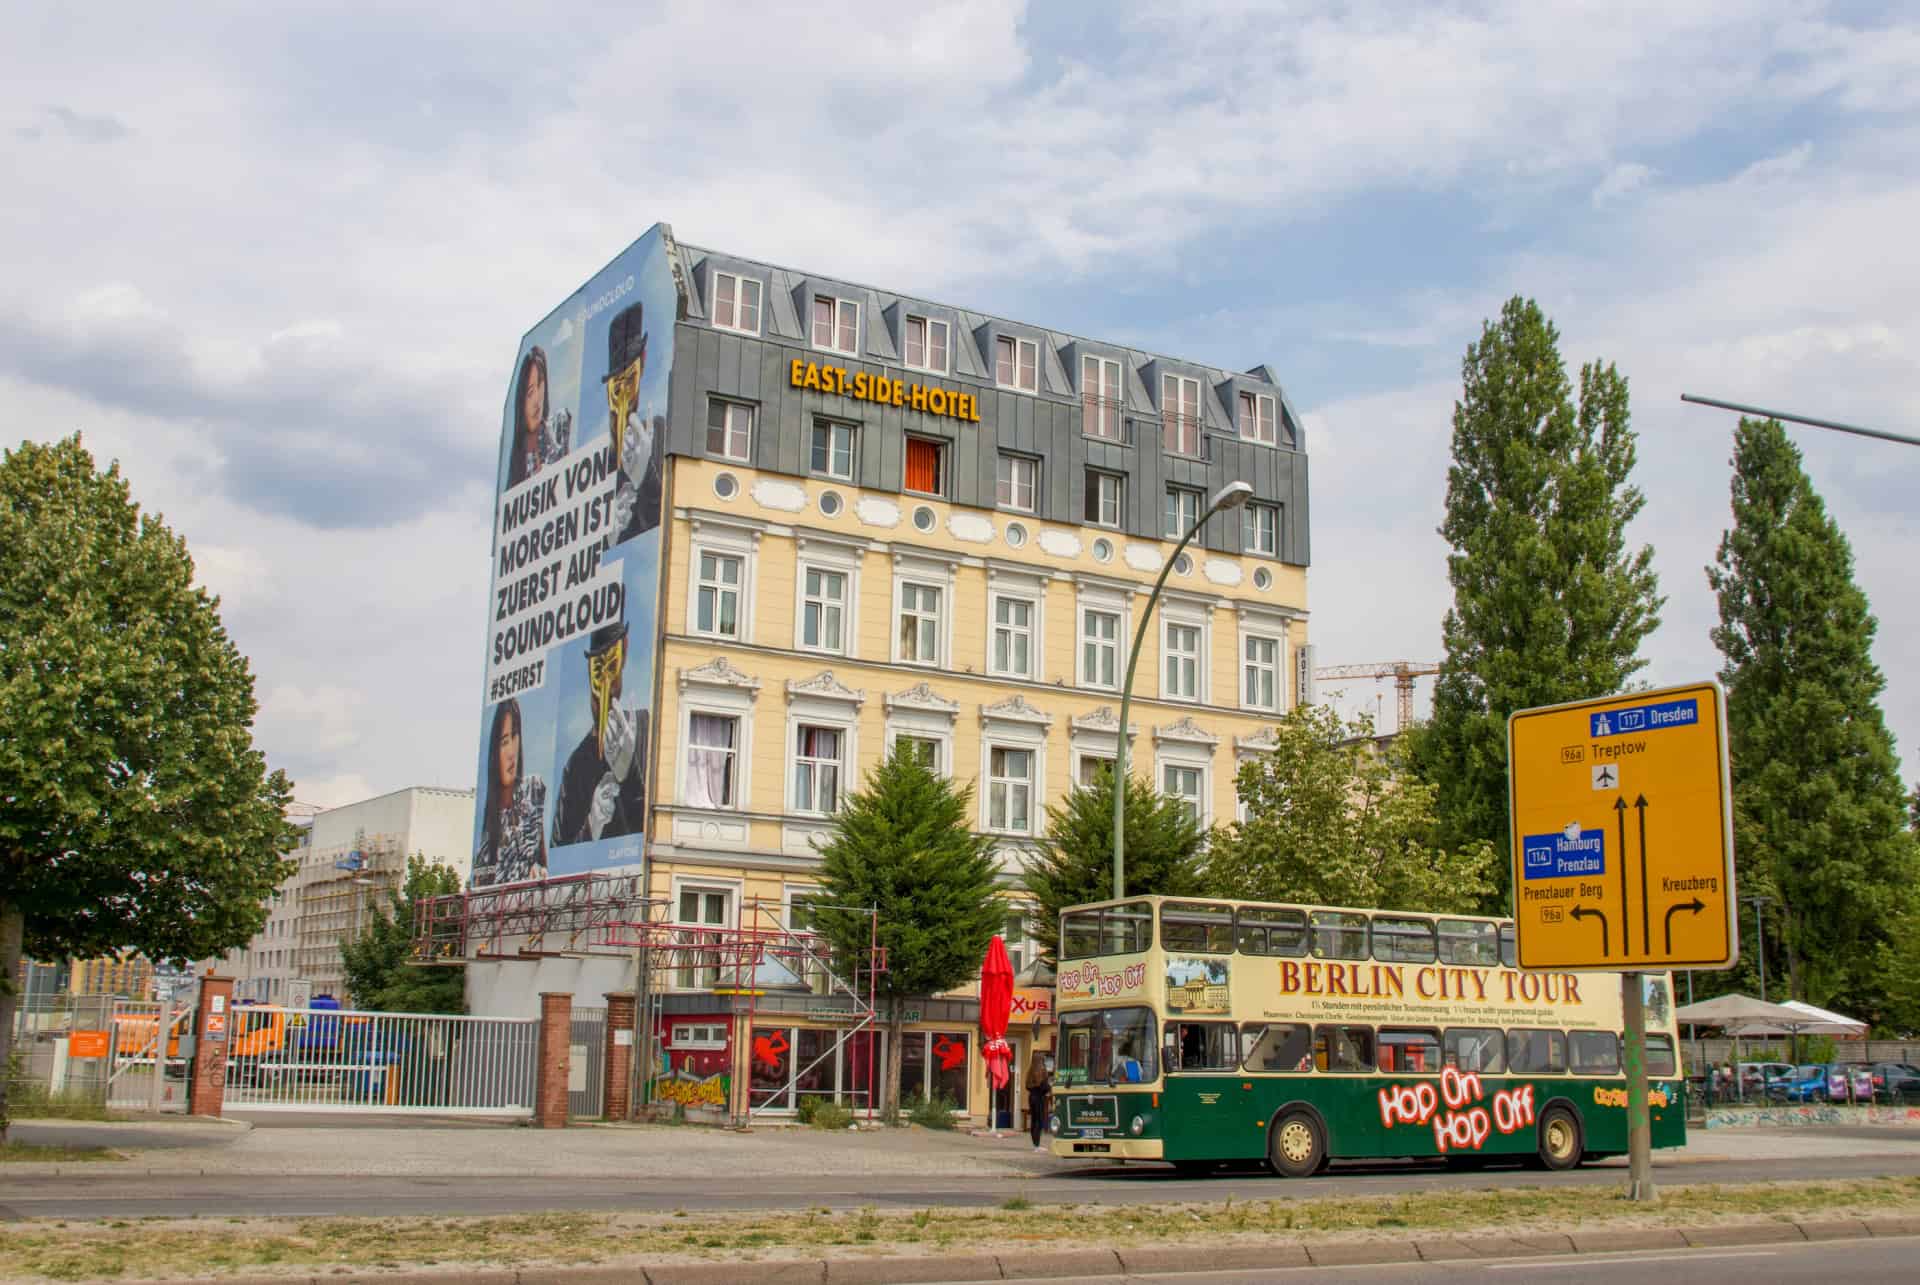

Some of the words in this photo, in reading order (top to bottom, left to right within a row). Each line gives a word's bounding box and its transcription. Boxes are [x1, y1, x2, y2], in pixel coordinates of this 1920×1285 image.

[502, 474, 560, 535] MUSIK
[565, 446, 610, 499] VON
[500, 507, 580, 578] MORGEN
[583, 488, 615, 537] IST
[496, 560, 562, 622] ZUERST
[565, 548, 604, 591] AUF
[493, 581, 621, 666] SOUNDCLOUD
[491, 660, 544, 702] #SCFIRST
[1622, 712, 1640, 728] 117
[1651, 706, 1694, 725] Dresden
[1563, 748, 1582, 761] 96a
[1592, 740, 1646, 760] Treptow
[1531, 850, 1547, 864] 114
[1557, 836, 1600, 853] Hamburg
[1557, 856, 1600, 873] Prenzlau
[1524, 884, 1575, 900] Prenzlauer
[1580, 882, 1603, 900] Berg
[1662, 875, 1718, 892] Kreuzberg
[1543, 908, 1562, 921] 96a
[1279, 960, 1405, 1000] BERLIN
[1416, 966, 1490, 1001] CITY
[1500, 971, 1583, 1005] TOUR
[1440, 1064, 1483, 1112] On
[1493, 1083, 1535, 1134] Off
